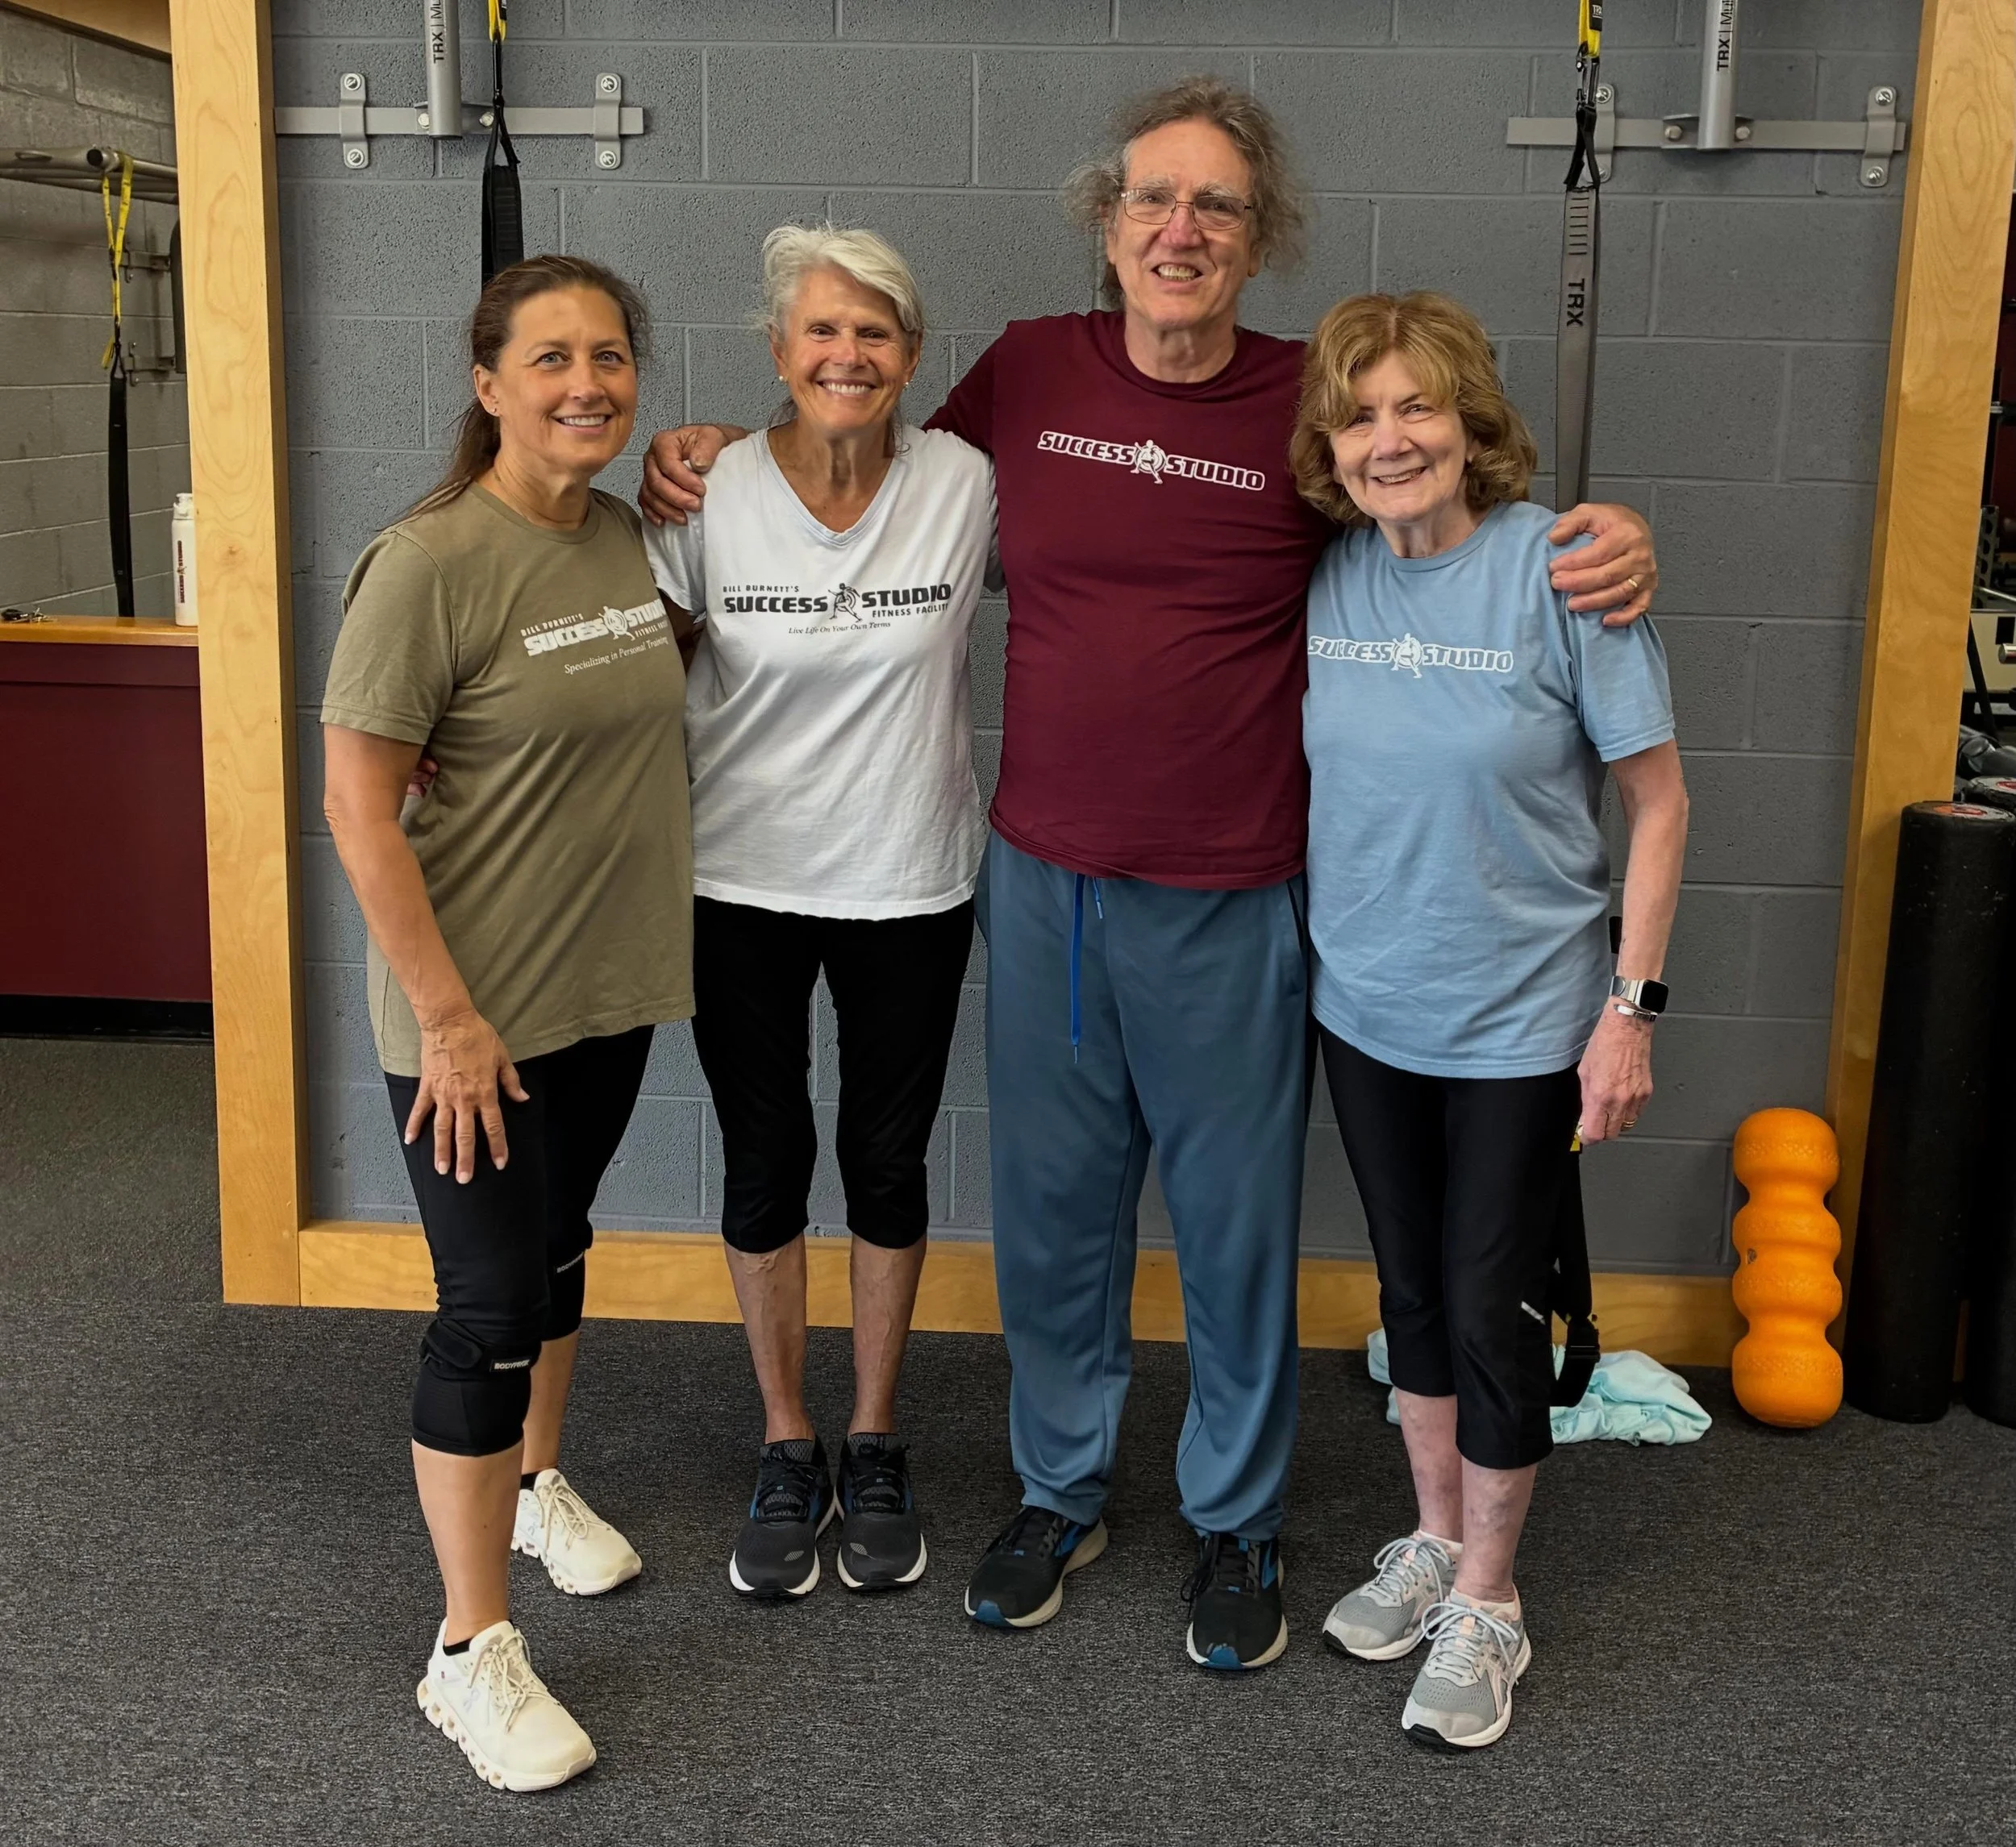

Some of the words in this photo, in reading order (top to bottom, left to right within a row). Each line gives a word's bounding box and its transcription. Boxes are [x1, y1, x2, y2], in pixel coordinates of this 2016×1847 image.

[431, 31, 444, 64] TRX
[1717, 39, 1731, 71] TRX
[1567, 278, 1585, 327] TRX
[1037, 431, 1135, 465] SUCCESS
[1164, 455, 1265, 490] STUDIO
[724, 596, 828, 613] SUCCESS
[861, 584, 952, 608] STUDIO
[746, 584, 799, 593] BURNETT'S
[873, 608, 911, 618] FITNESS
[523, 618, 610, 656] SUCCESS
[788, 626, 804, 634] Live
[805, 626, 819, 635] Life
[564, 654, 610, 675] Specializing
[610, 651, 619, 660] in
[619, 642, 647, 658] Personal
[1308, 635, 1393, 664] SUCCESS
[1421, 643, 1514, 672] STUDIO
